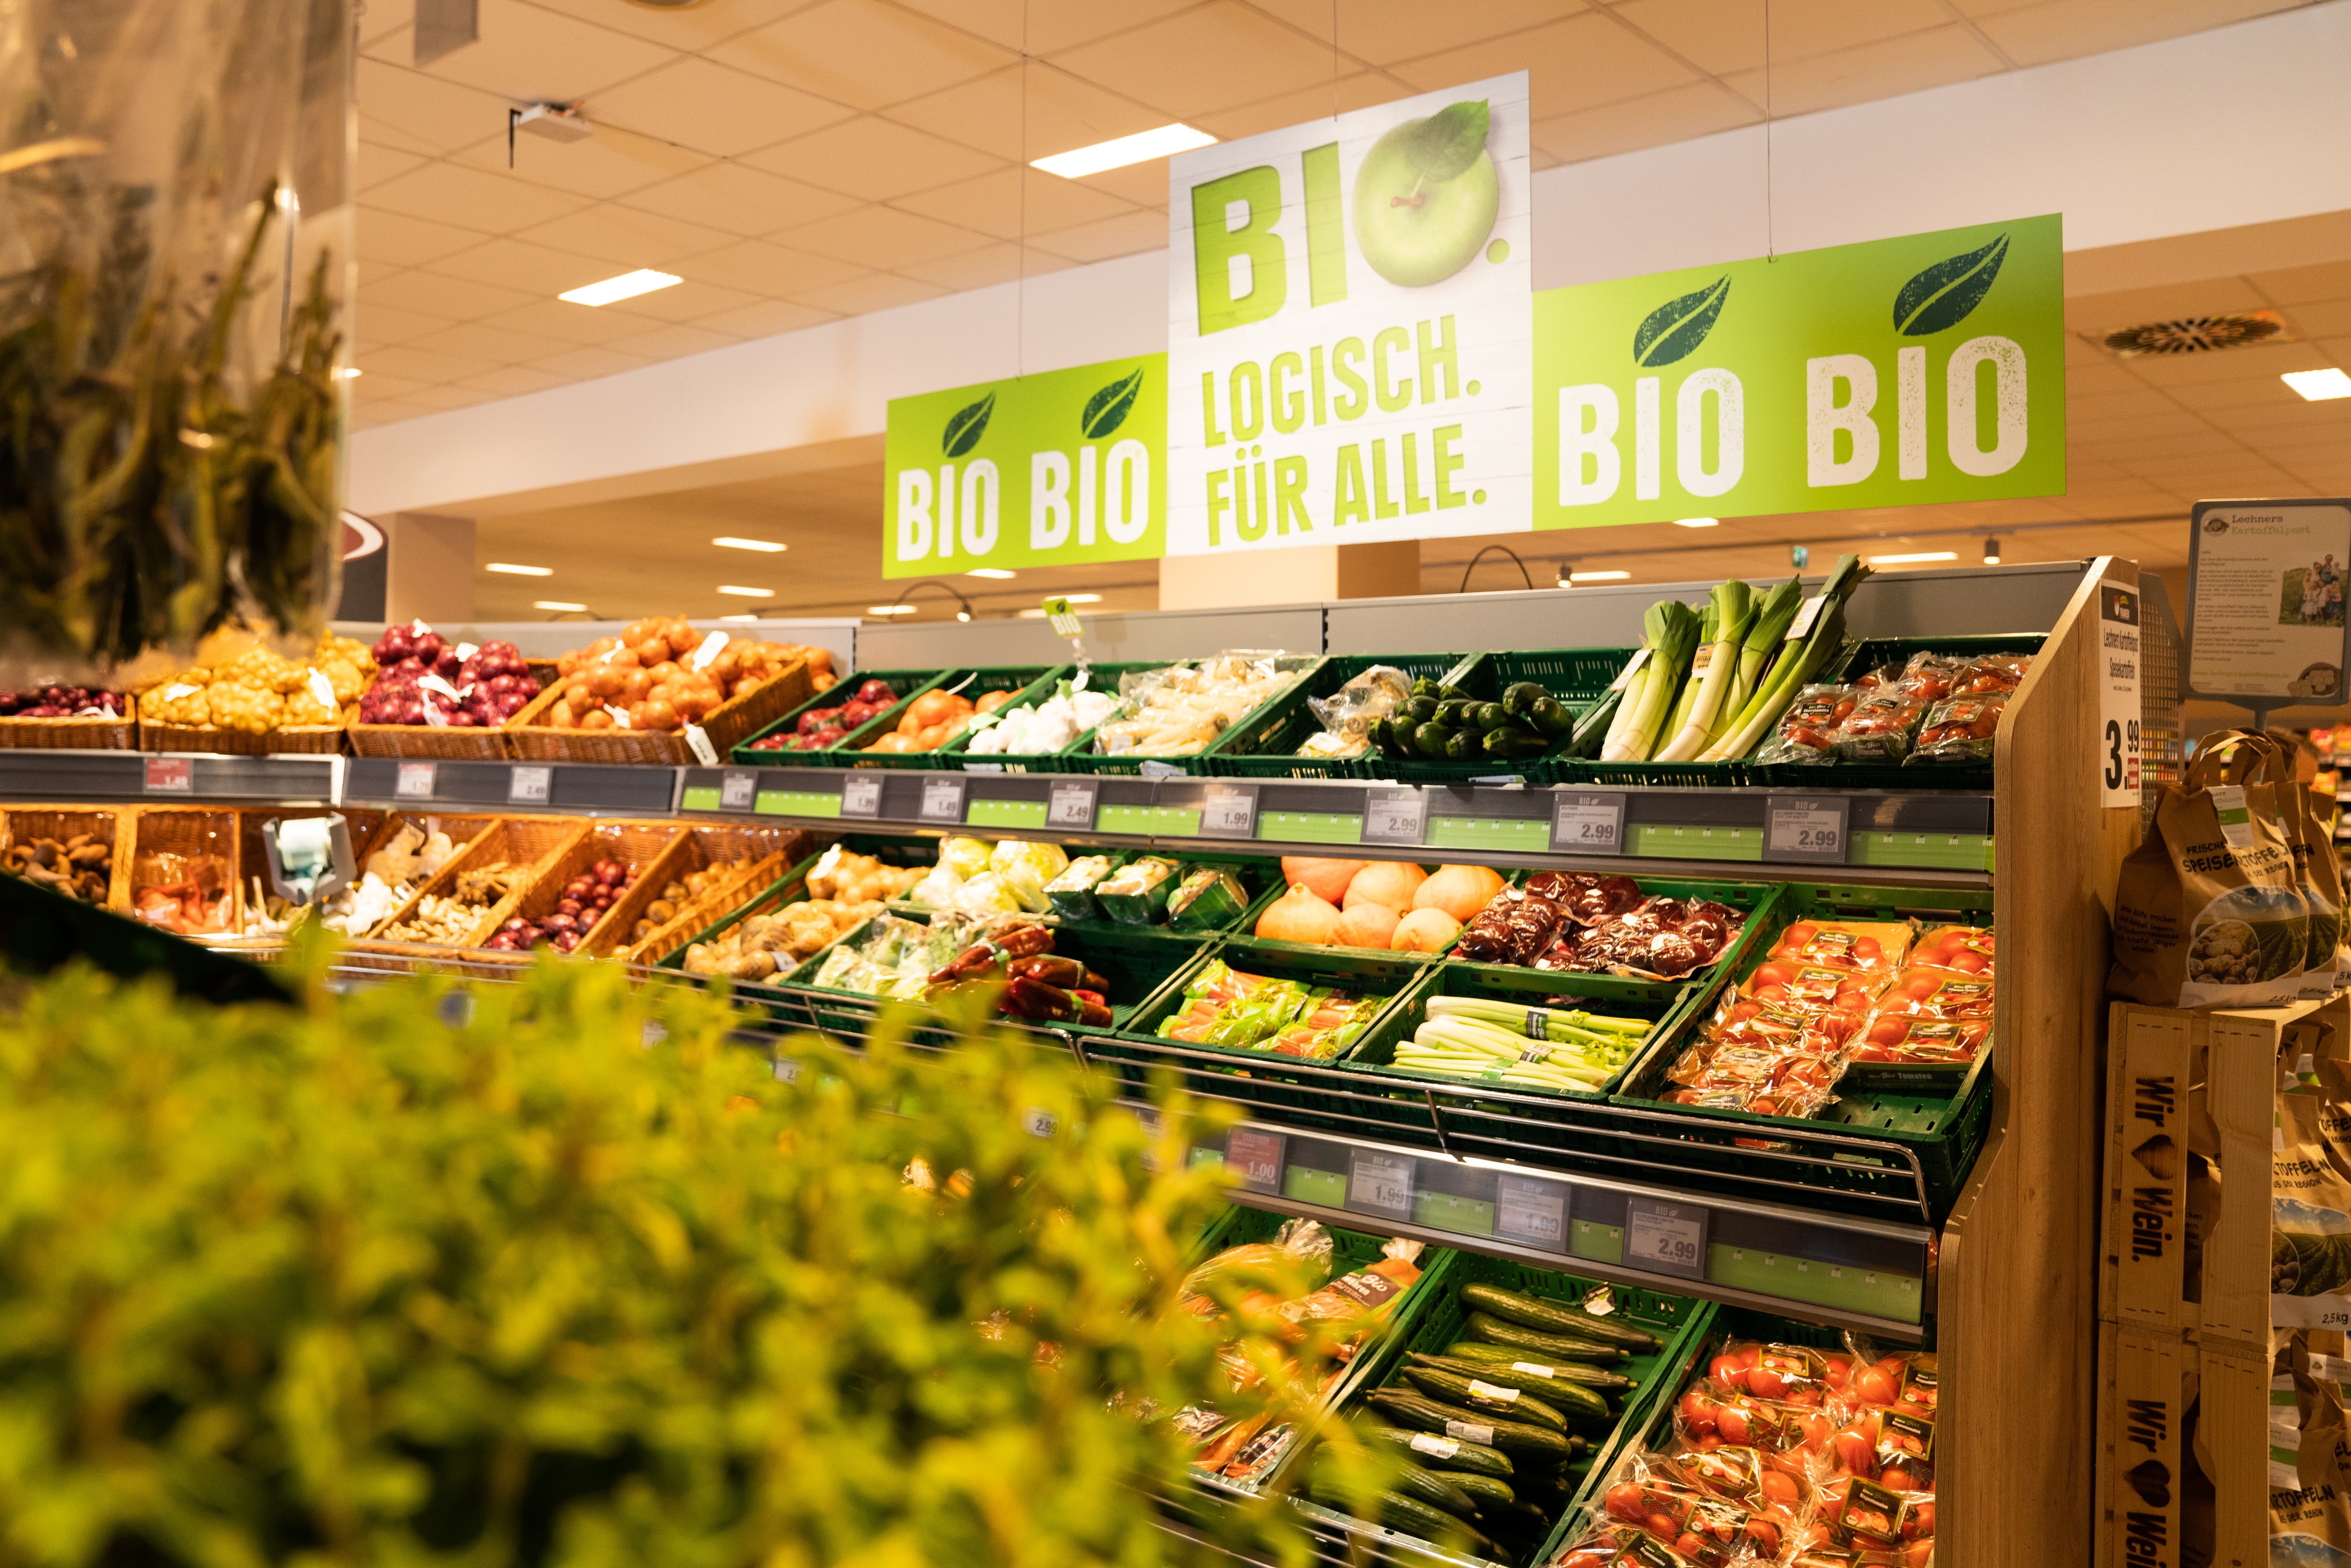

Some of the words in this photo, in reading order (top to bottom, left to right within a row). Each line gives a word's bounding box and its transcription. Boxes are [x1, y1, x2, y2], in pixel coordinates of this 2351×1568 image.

[1202, 314, 1481, 449] LOGISCH.
[1558, 367, 1745, 507] BIO
[1806, 335, 2028, 488] BIO
[1206, 444, 1314, 547] FÜR
[1334, 423, 1487, 527] ALLE.
[897, 457, 999, 562] BIO
[1030, 439, 1150, 550] BIO
[2232, 515, 2283, 523] Lechners
[2232, 526, 2311, 536] Kartoffelpost
[1049, 612, 1082, 636] BIO
[1066, 804, 1088, 818] 2.49
[1224, 812, 1248, 825] 1.99
[1389, 818, 1418, 831] 2.99
[1581, 824, 1613, 839] 2.99
[1799, 830, 1837, 846] 2.99
[2186, 841, 2225, 855] FRISCHE
[2134, 1076, 2175, 1128] Wir
[1035, 1119, 1057, 1134] 2.99
[1248, 1161, 1275, 1179] 1.00
[1373, 1156, 1383, 1166] BIO
[2295, 1177, 2322, 1189] REGION
[1375, 1185, 1404, 1204] 1.99
[1655, 1206, 1668, 1216] BIO
[1527, 1213, 1559, 1234] 1.99
[2132, 1187, 2173, 1262] Wein.
[1658, 1238, 1696, 1260] 2.99
[1341, 1275, 1371, 1297] Möhren
[1361, 1274, 1388, 1292] Bio
[1892, 1420, 1921, 1434] Rispentomaten
[2126, 1399, 2166, 1454] Wir
[1860, 1492, 1888, 1510] Rispentomaten
[2126, 1512, 2167, 1568] Wei
[1640, 1546, 1666, 1567] Rispentomaten
